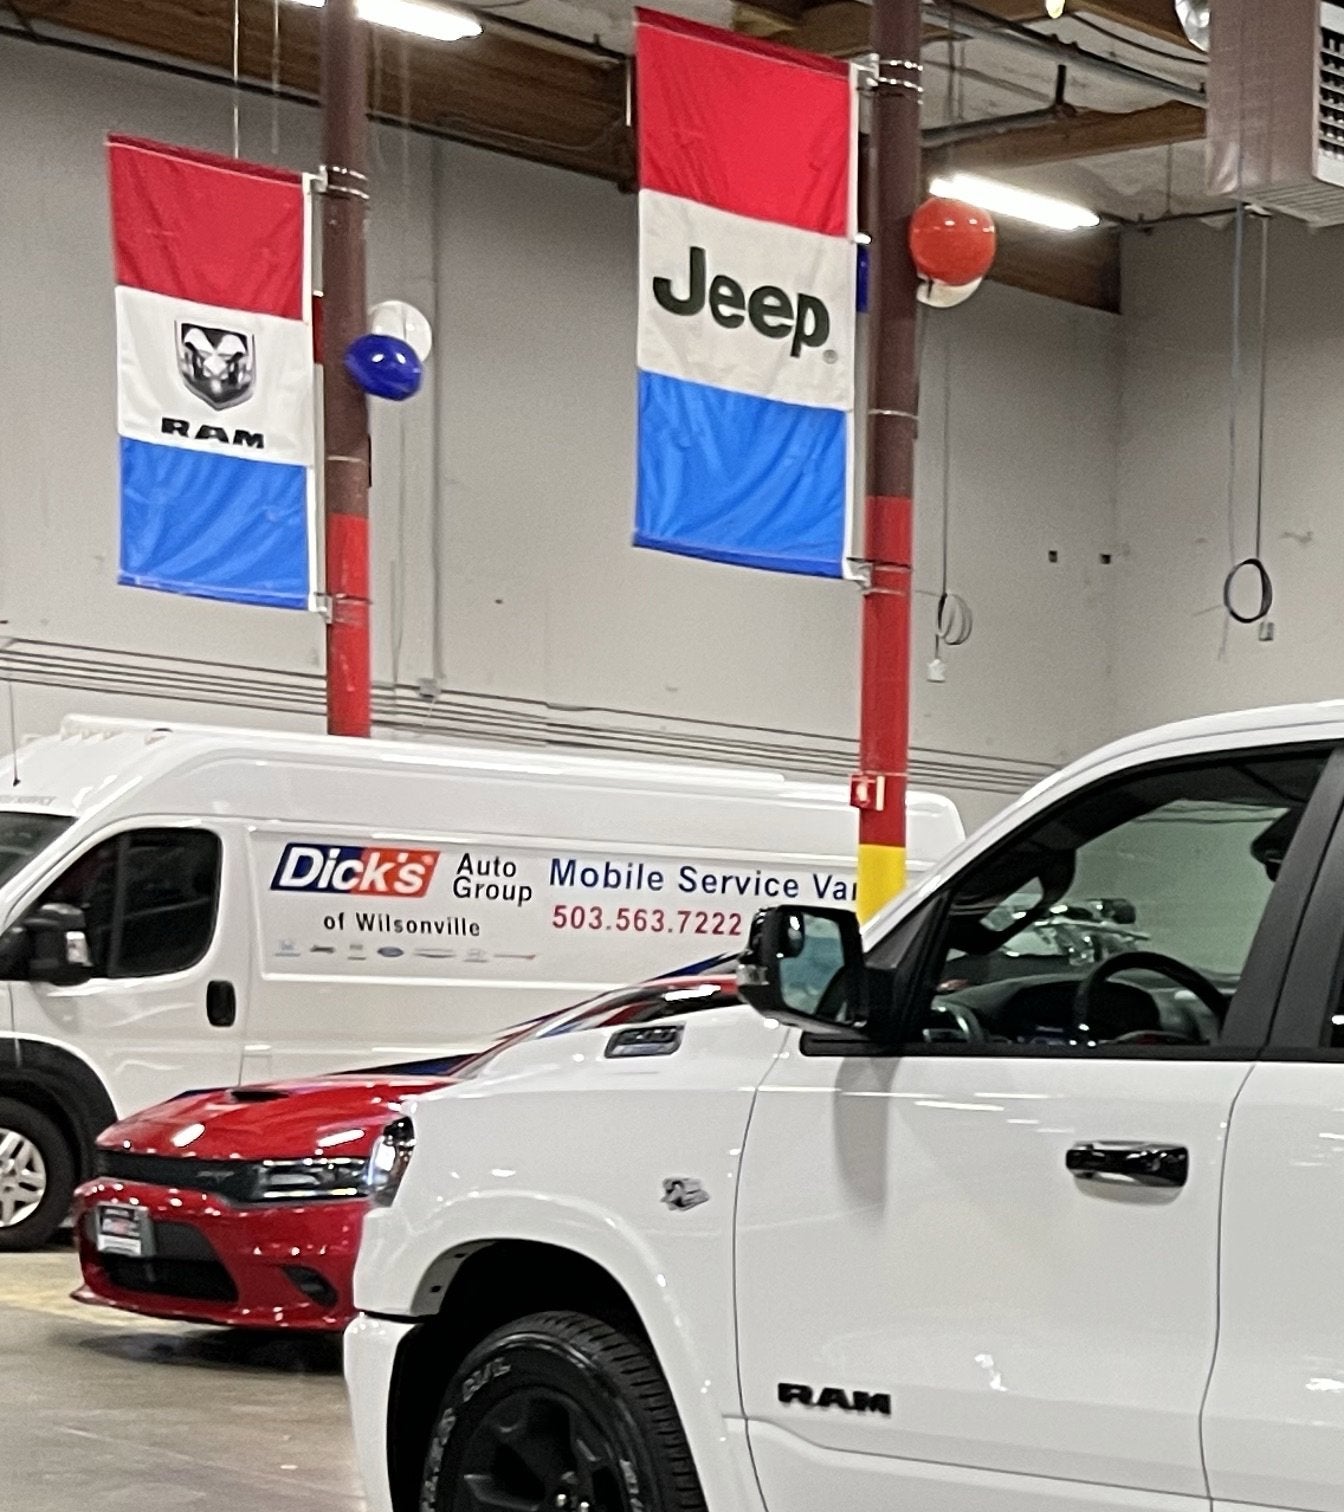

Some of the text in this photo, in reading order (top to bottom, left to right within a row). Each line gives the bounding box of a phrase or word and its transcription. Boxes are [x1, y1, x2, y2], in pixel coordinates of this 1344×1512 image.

[652, 246, 831, 358] Jeep
[161, 417, 264, 449] RAM
[456, 852, 517, 877] Auto
[549, 858, 665, 892] Mobile
[678, 865, 800, 899] Service
[452, 876, 533, 907] Group
[323, 912, 480, 937] of Wilsonville
[551, 904, 743, 936] 503.563.7222
[778, 1382, 892, 1416] RAM
